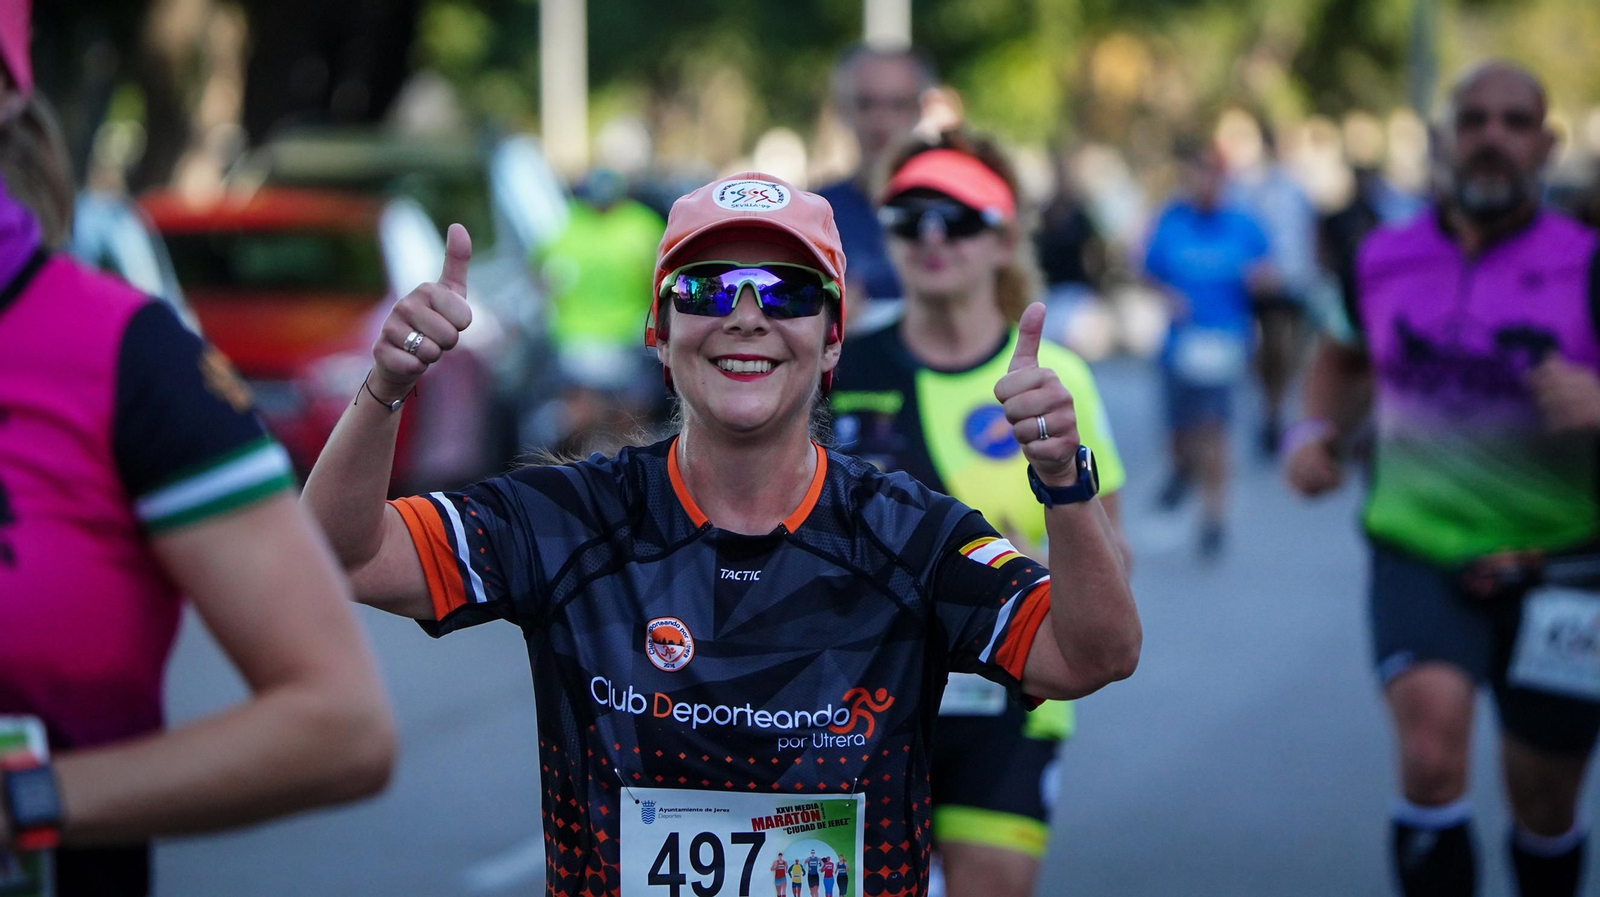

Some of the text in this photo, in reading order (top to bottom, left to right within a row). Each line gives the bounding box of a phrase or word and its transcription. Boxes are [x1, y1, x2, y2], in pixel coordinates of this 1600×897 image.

[720, 568, 762, 581] TACTIC
[679, 627, 689, 639] por
[590, 675, 851, 730] Club Deporteando
[777, 732, 867, 752] por Utrera
[775, 802, 820, 815] XXVI MEDIA
[816, 821, 828, 831] DE
[647, 831, 767, 897] 497
